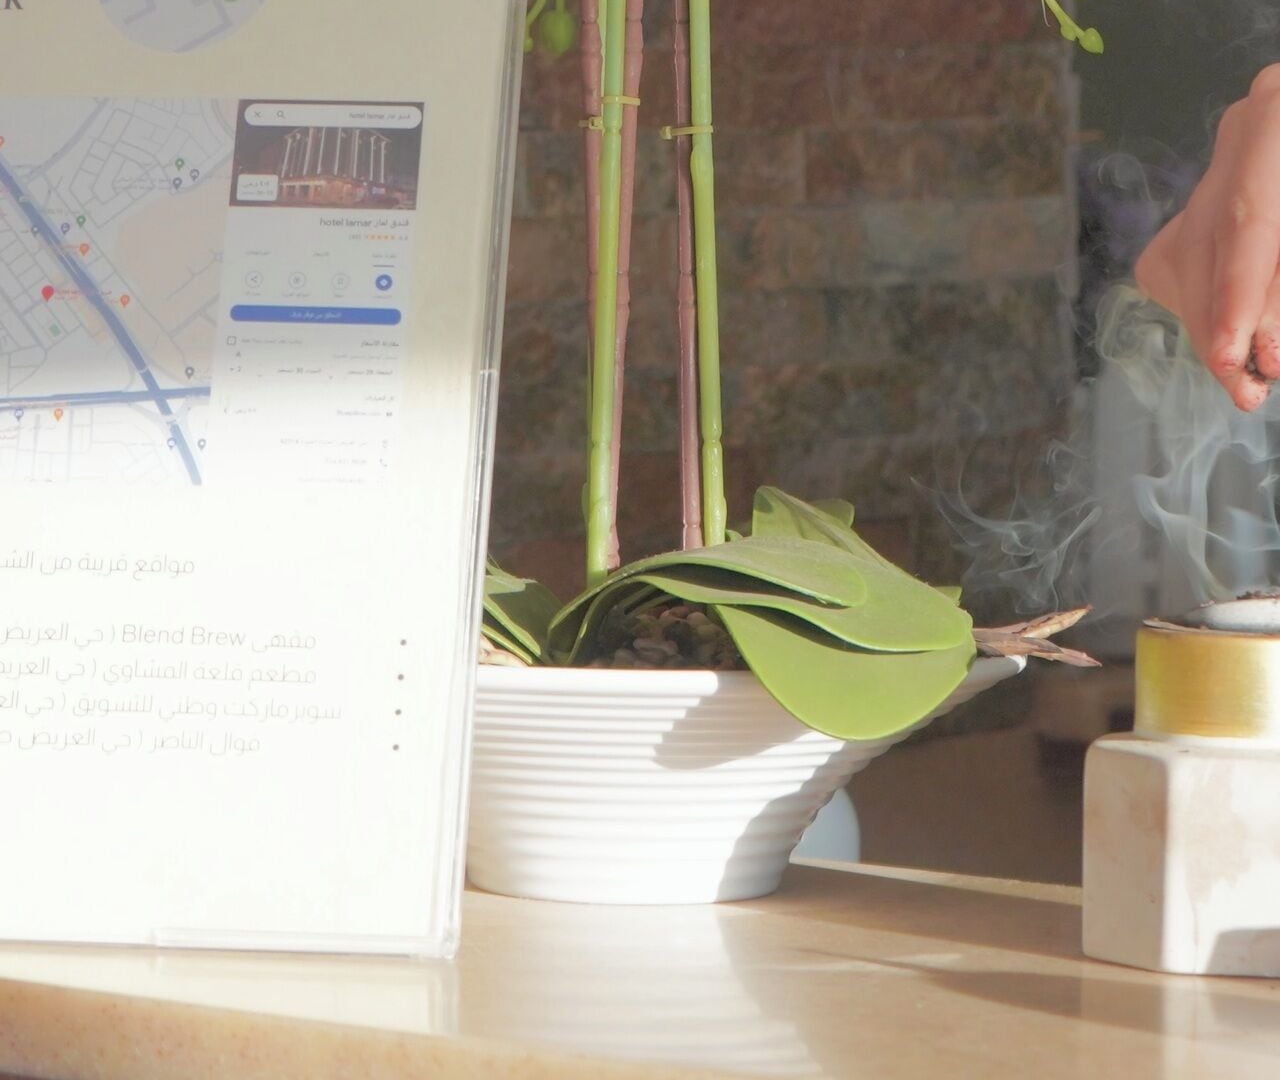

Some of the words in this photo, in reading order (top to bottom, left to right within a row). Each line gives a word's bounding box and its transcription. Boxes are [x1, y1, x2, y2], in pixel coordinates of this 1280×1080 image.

[319, 217, 344, 228] hotel
[39, 552, 73, 576] من
[77, 551, 128, 576] قريبة
[132, 552, 195, 580] مواقع
[121, 624, 186, 645] Blend
[190, 626, 247, 647] Brew
[249, 663, 317, 690] مطعم
